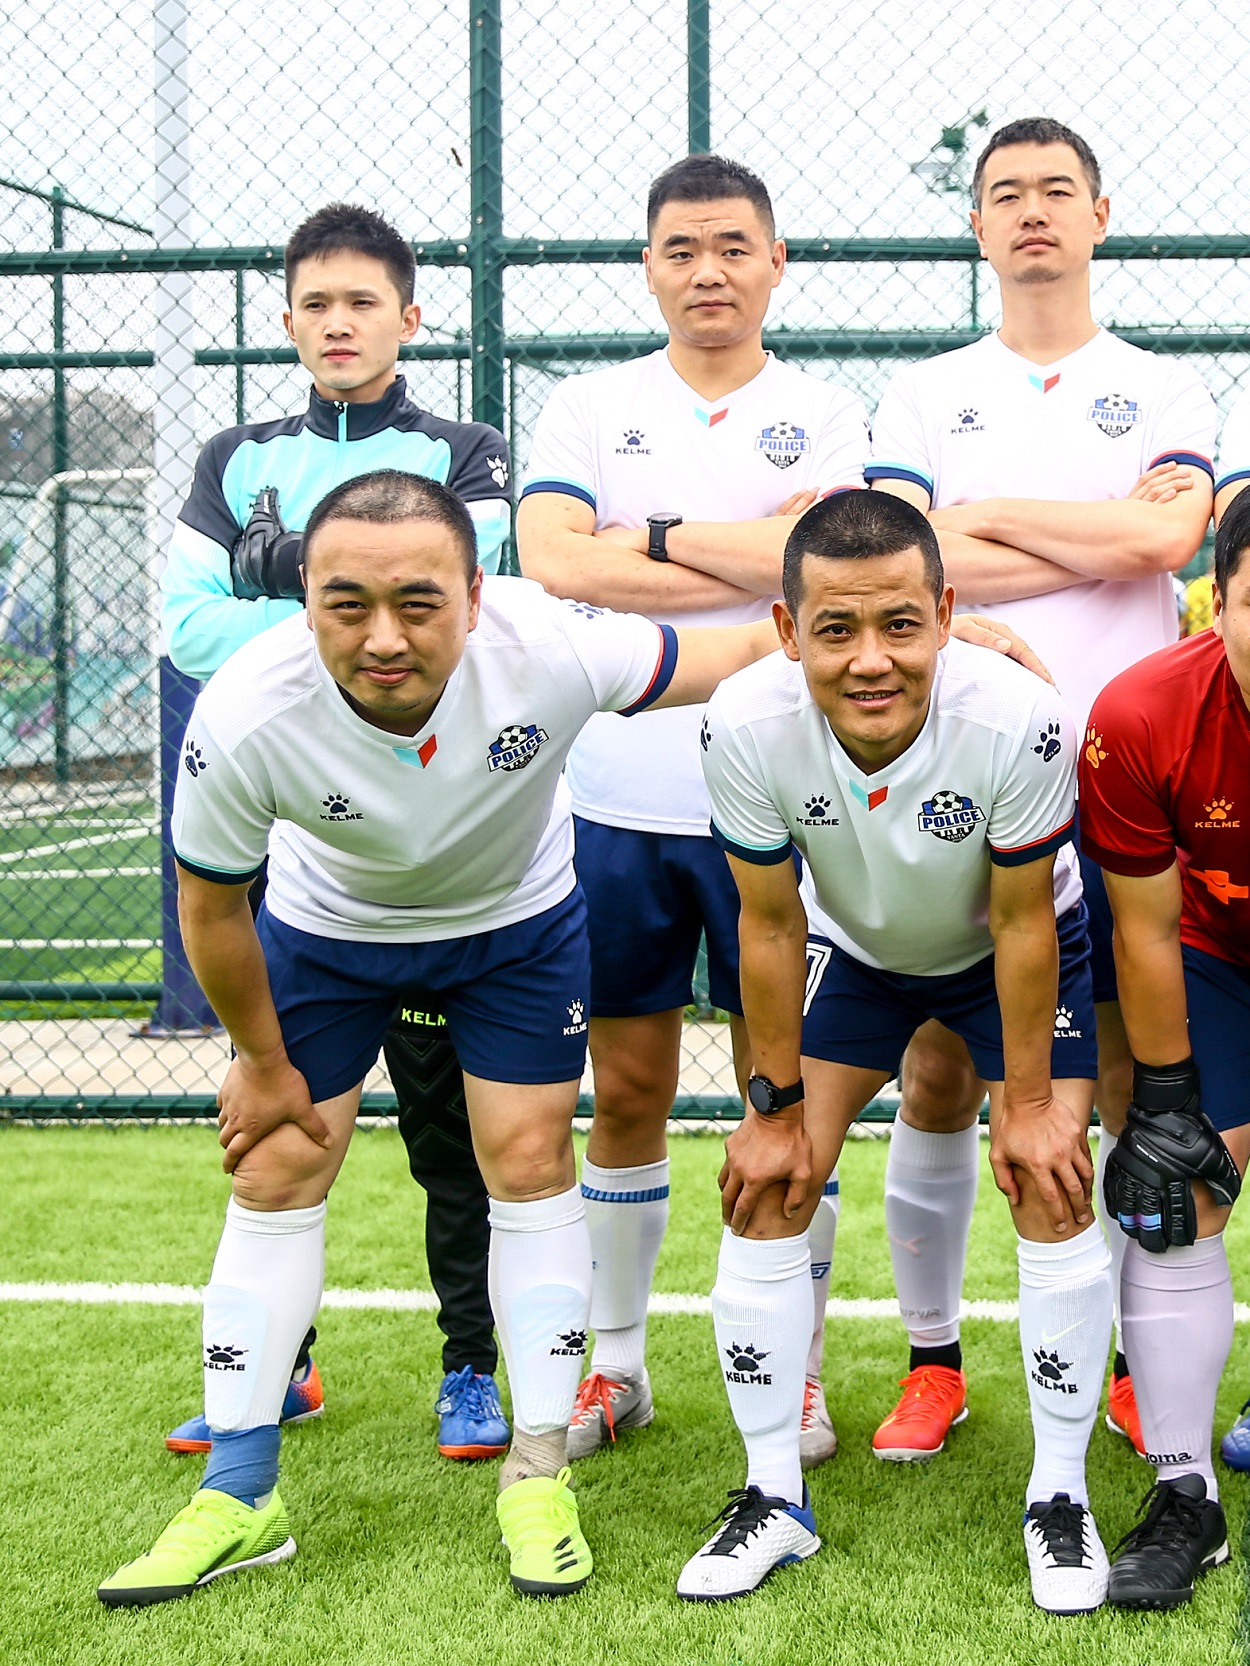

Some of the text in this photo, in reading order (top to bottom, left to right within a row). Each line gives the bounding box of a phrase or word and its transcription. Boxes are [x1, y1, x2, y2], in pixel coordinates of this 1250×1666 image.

[1091, 410, 1139, 423] POLICE
[951, 425, 986, 434] KELME
[615, 447, 652, 455] KELME
[759, 439, 807, 452] POLICE
[491, 732, 545, 768] POLICE
[319, 812, 364, 822] KELME
[796, 817, 840, 826] KELME
[922, 810, 981, 829] POLICE
[1194, 820, 1241, 828] KELME
[401, 1008, 448, 1026] KELM
[563, 1021, 588, 1036] KELME
[1053, 1030, 1083, 1038] ELME
[203, 1361, 246, 1371] KELME
[725, 1371, 773, 1385] KELME
[1031, 1370, 1079, 1394] KELME
